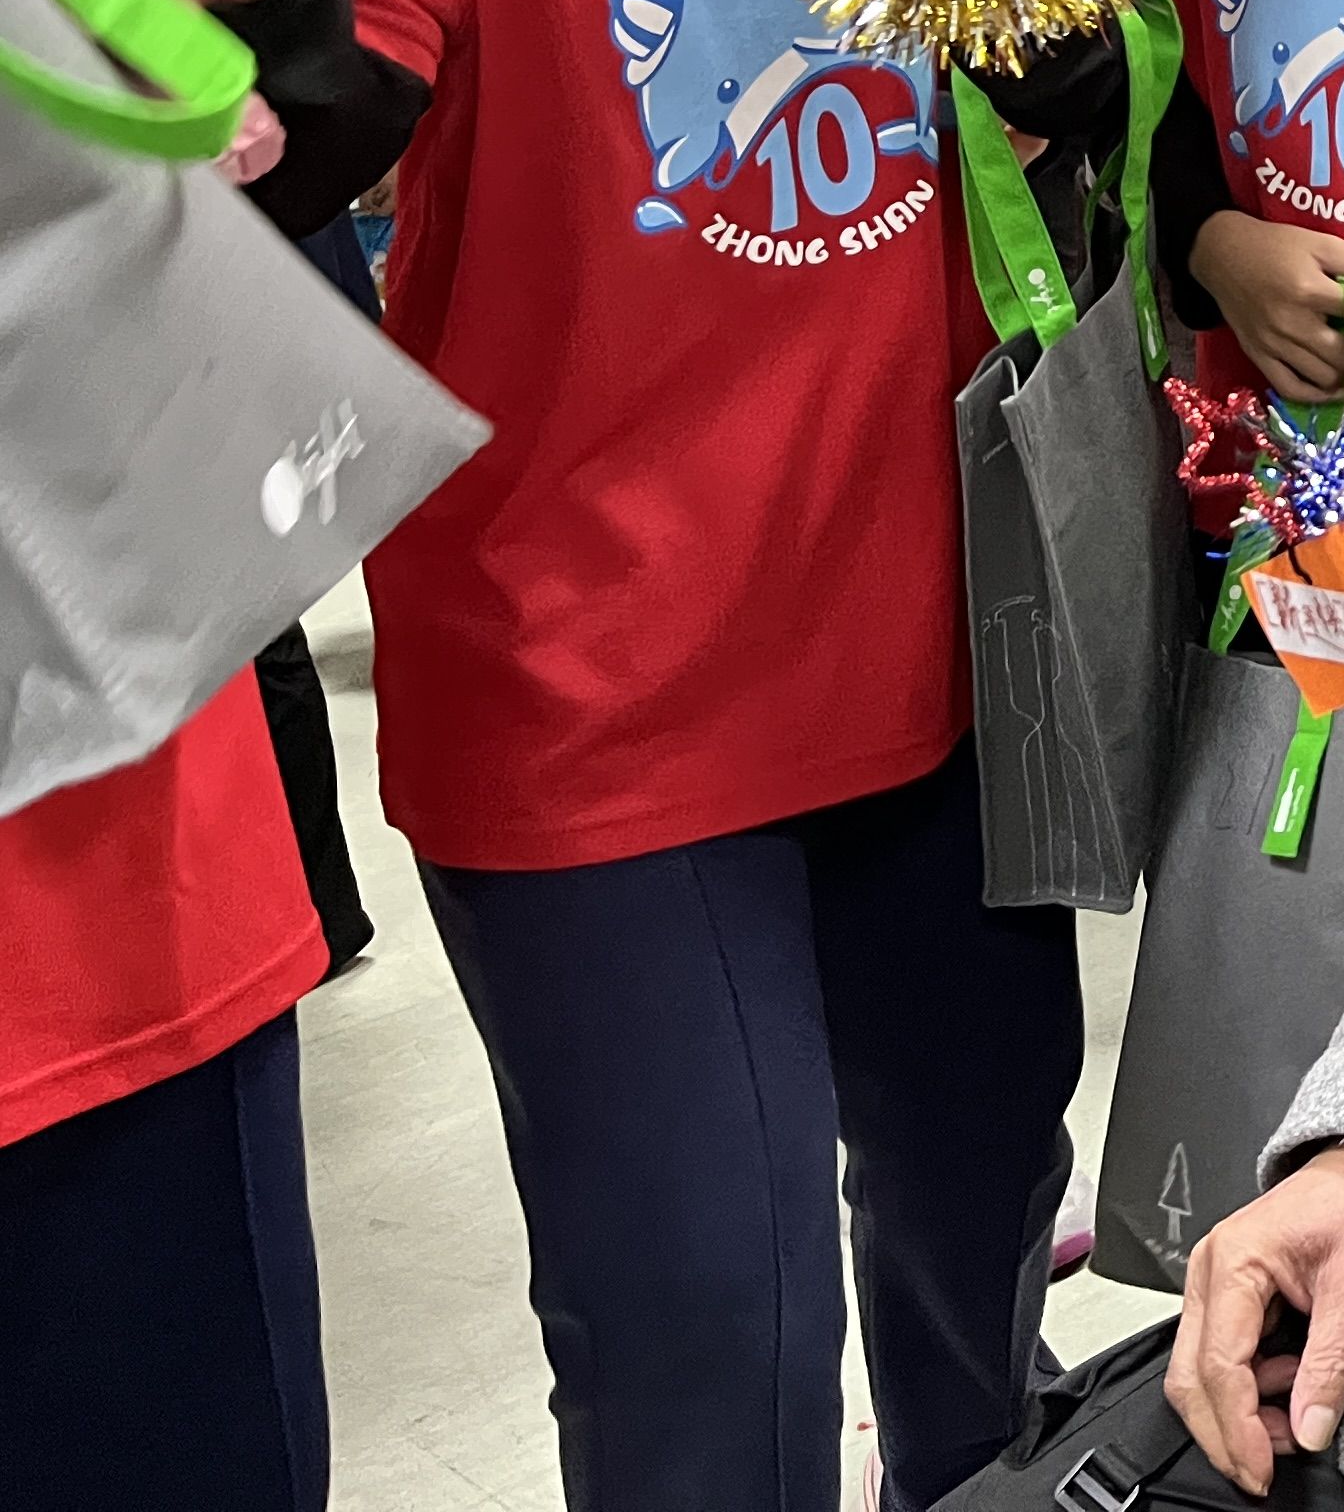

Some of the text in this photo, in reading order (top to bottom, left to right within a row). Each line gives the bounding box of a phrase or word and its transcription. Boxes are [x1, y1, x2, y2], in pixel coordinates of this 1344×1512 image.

[755, 83, 876, 233] 10
[701, 179, 935, 266] ZHONG SHAN
